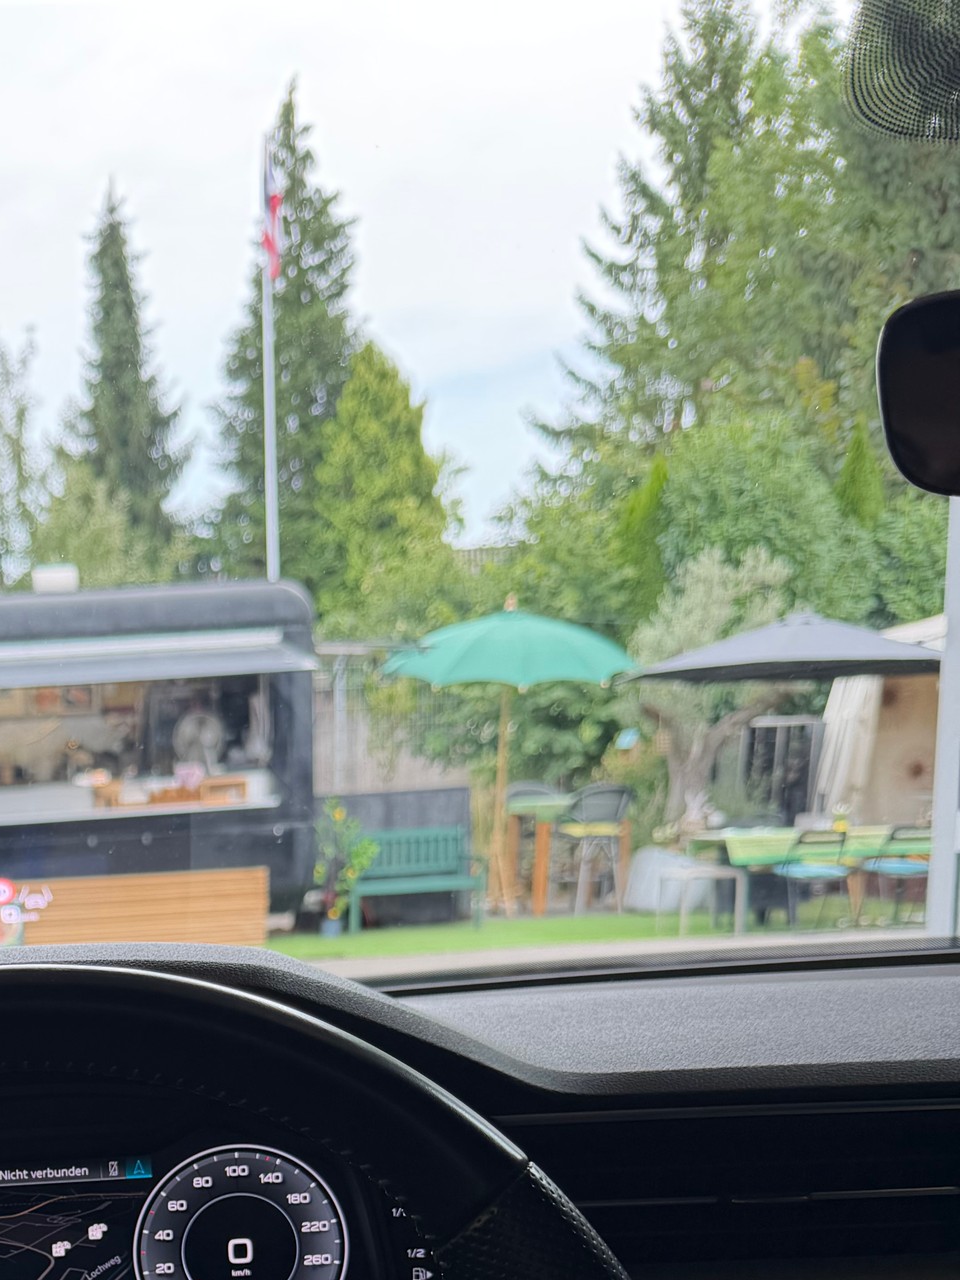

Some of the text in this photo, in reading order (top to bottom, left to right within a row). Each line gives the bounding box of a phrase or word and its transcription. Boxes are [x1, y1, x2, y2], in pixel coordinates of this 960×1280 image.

[0, 1165, 89, 1180] Nicht verbunden
[224, 1165, 249, 1177] 100
[193, 1176, 213, 1188] 80
[259, 1172, 283, 1184] 140
[286, 1192, 311, 1205] 180
[167, 1200, 187, 1211] 60
[392, 1207, 406, 1217] 1/
[301, 1220, 329, 1233] 220
[154, 1229, 173, 1241] 40
[227, 1237, 253, 1264] 0
[407, 1248, 425, 1258] 1/2
[303, 1254, 331, 1266] 260
[85, 1254, 122, 1280] Lochweg
[155, 1263, 175, 1274] 20
[231, 1268, 252, 1277] km/h
